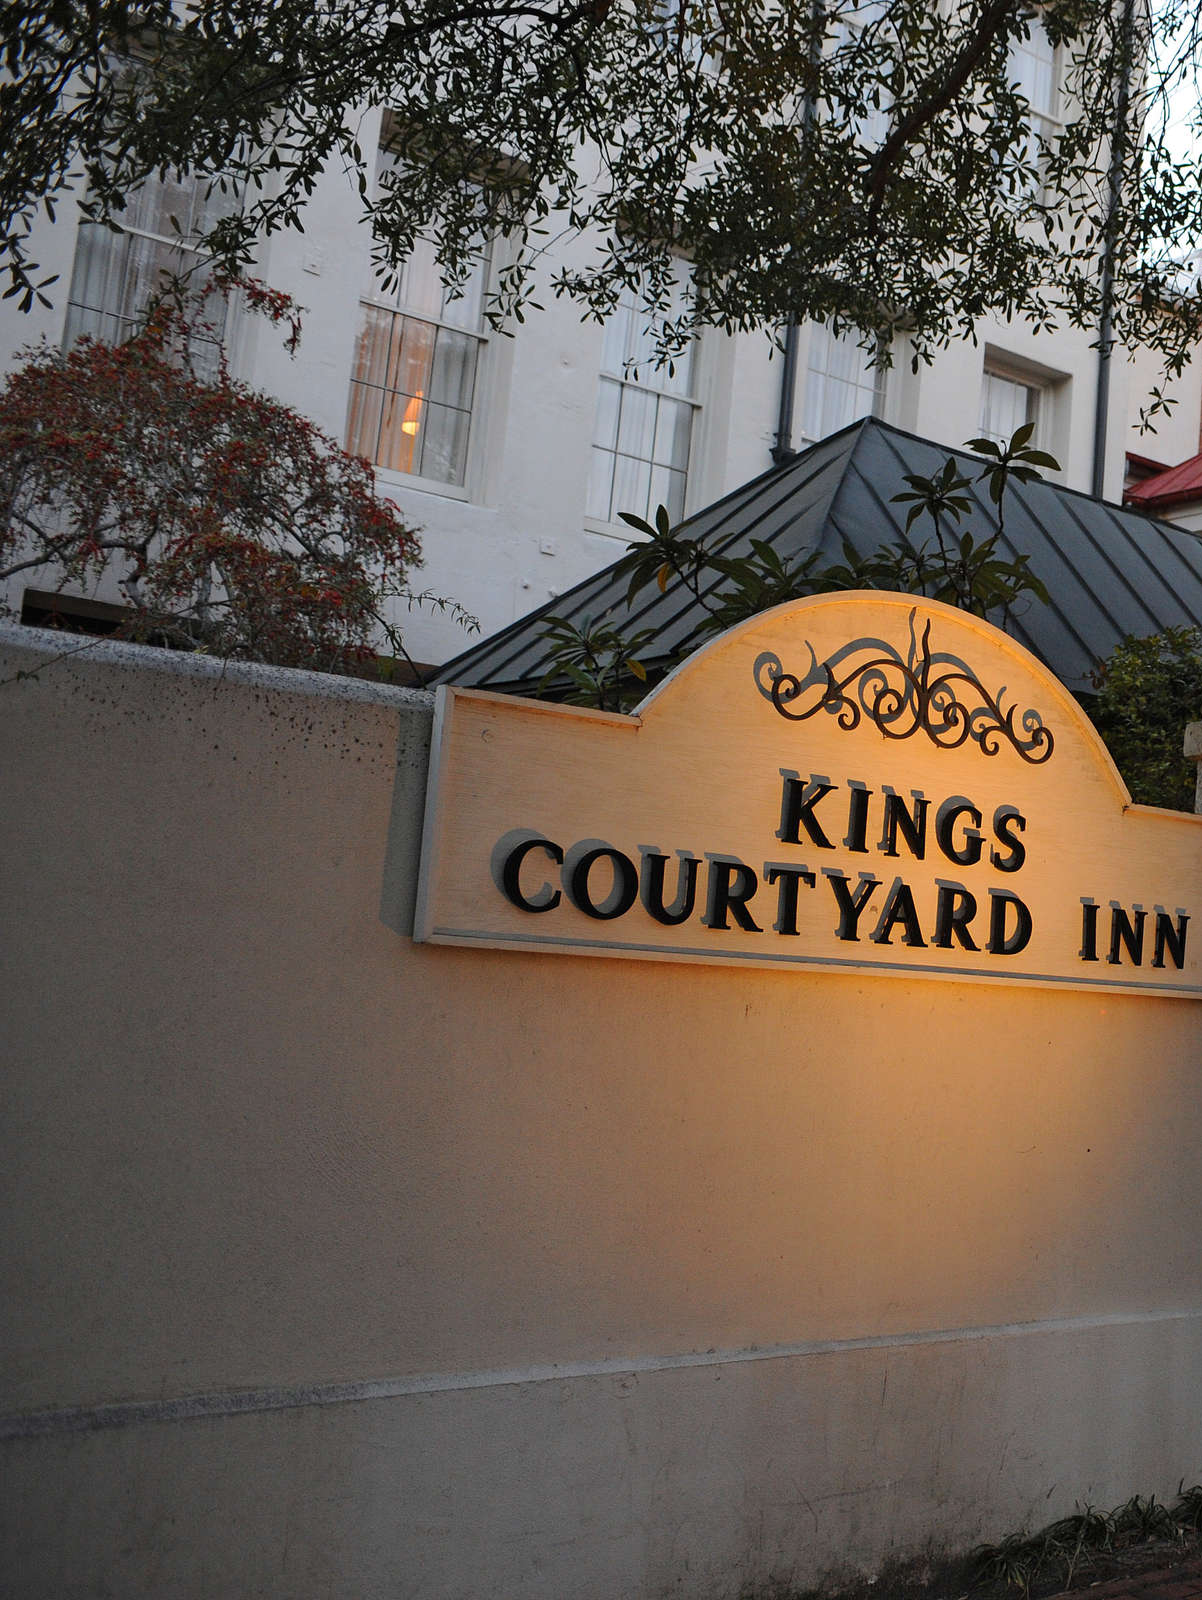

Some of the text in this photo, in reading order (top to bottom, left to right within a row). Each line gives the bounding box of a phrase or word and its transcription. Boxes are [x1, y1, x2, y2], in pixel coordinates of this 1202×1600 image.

[778, 776, 1028, 873] KINGS
[500, 838, 1192, 970] COURTYARD INN
